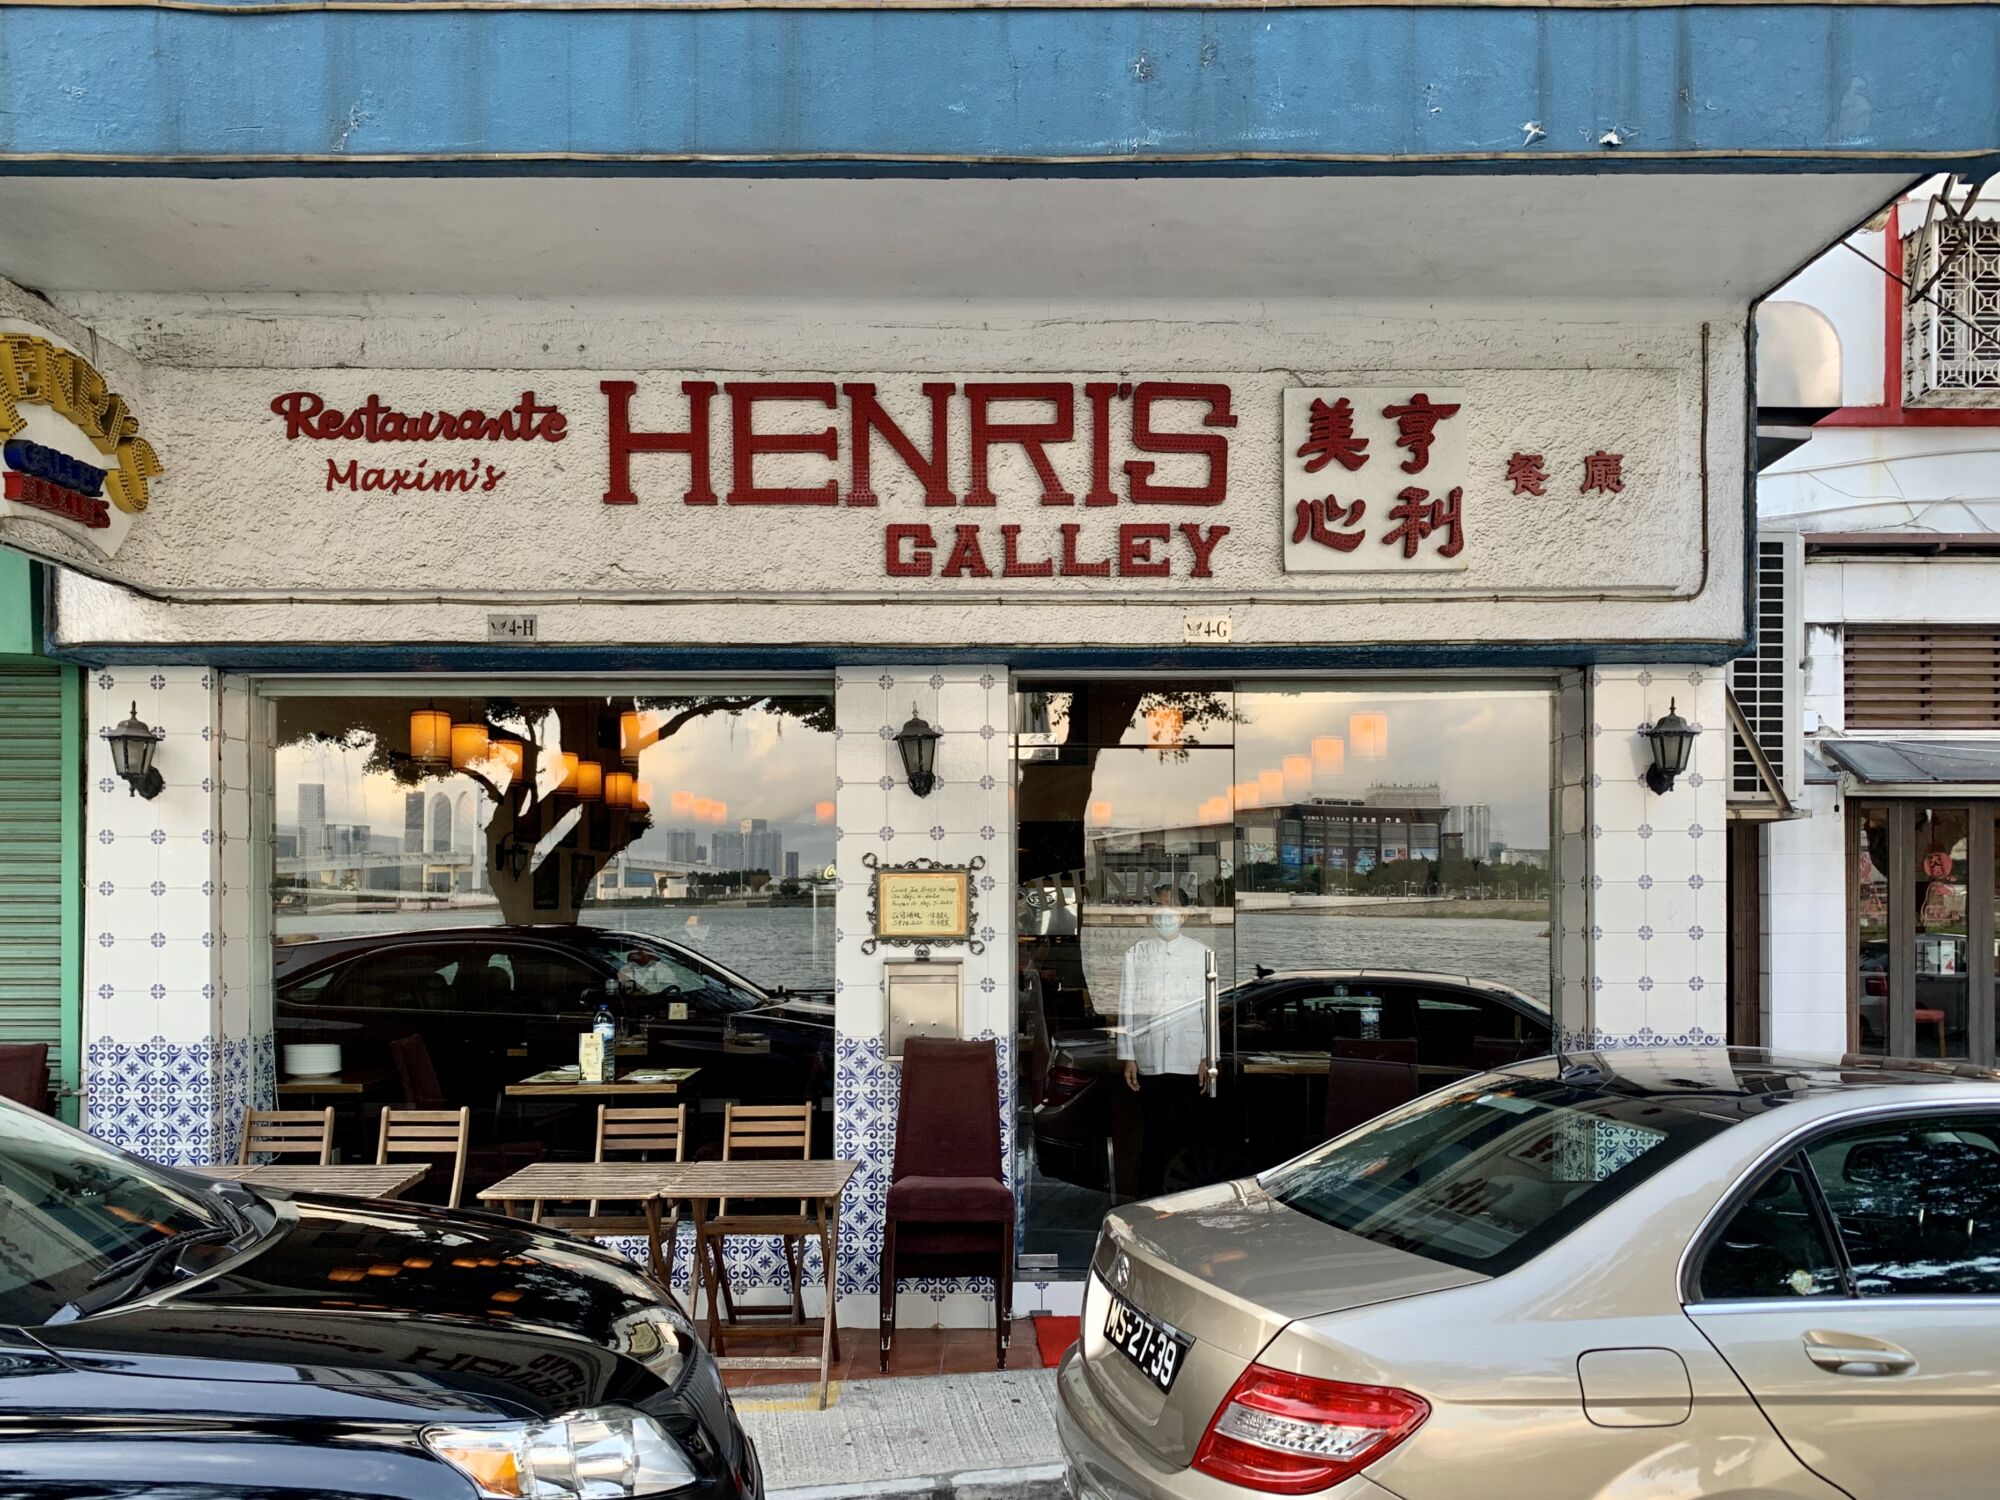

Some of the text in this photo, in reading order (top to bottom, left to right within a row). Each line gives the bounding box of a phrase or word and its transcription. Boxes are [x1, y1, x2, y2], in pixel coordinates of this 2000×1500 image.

[270, 391, 567, 443] Restaurante
[600, 380, 1238, 506] HENRI'S
[326, 458, 506, 494] Maxim's
[1292, 397, 1370, 553] 美心
[1382, 392, 1463, 559] 亨利
[1505, 449, 1625, 496] 餐廳
[885, 523, 1230, 578] GALLEY
[508, 619, 534, 636] 4-H
[1204, 620, 1227, 637] 4-G
[1105, 1297, 1177, 1386] MS-27-39
